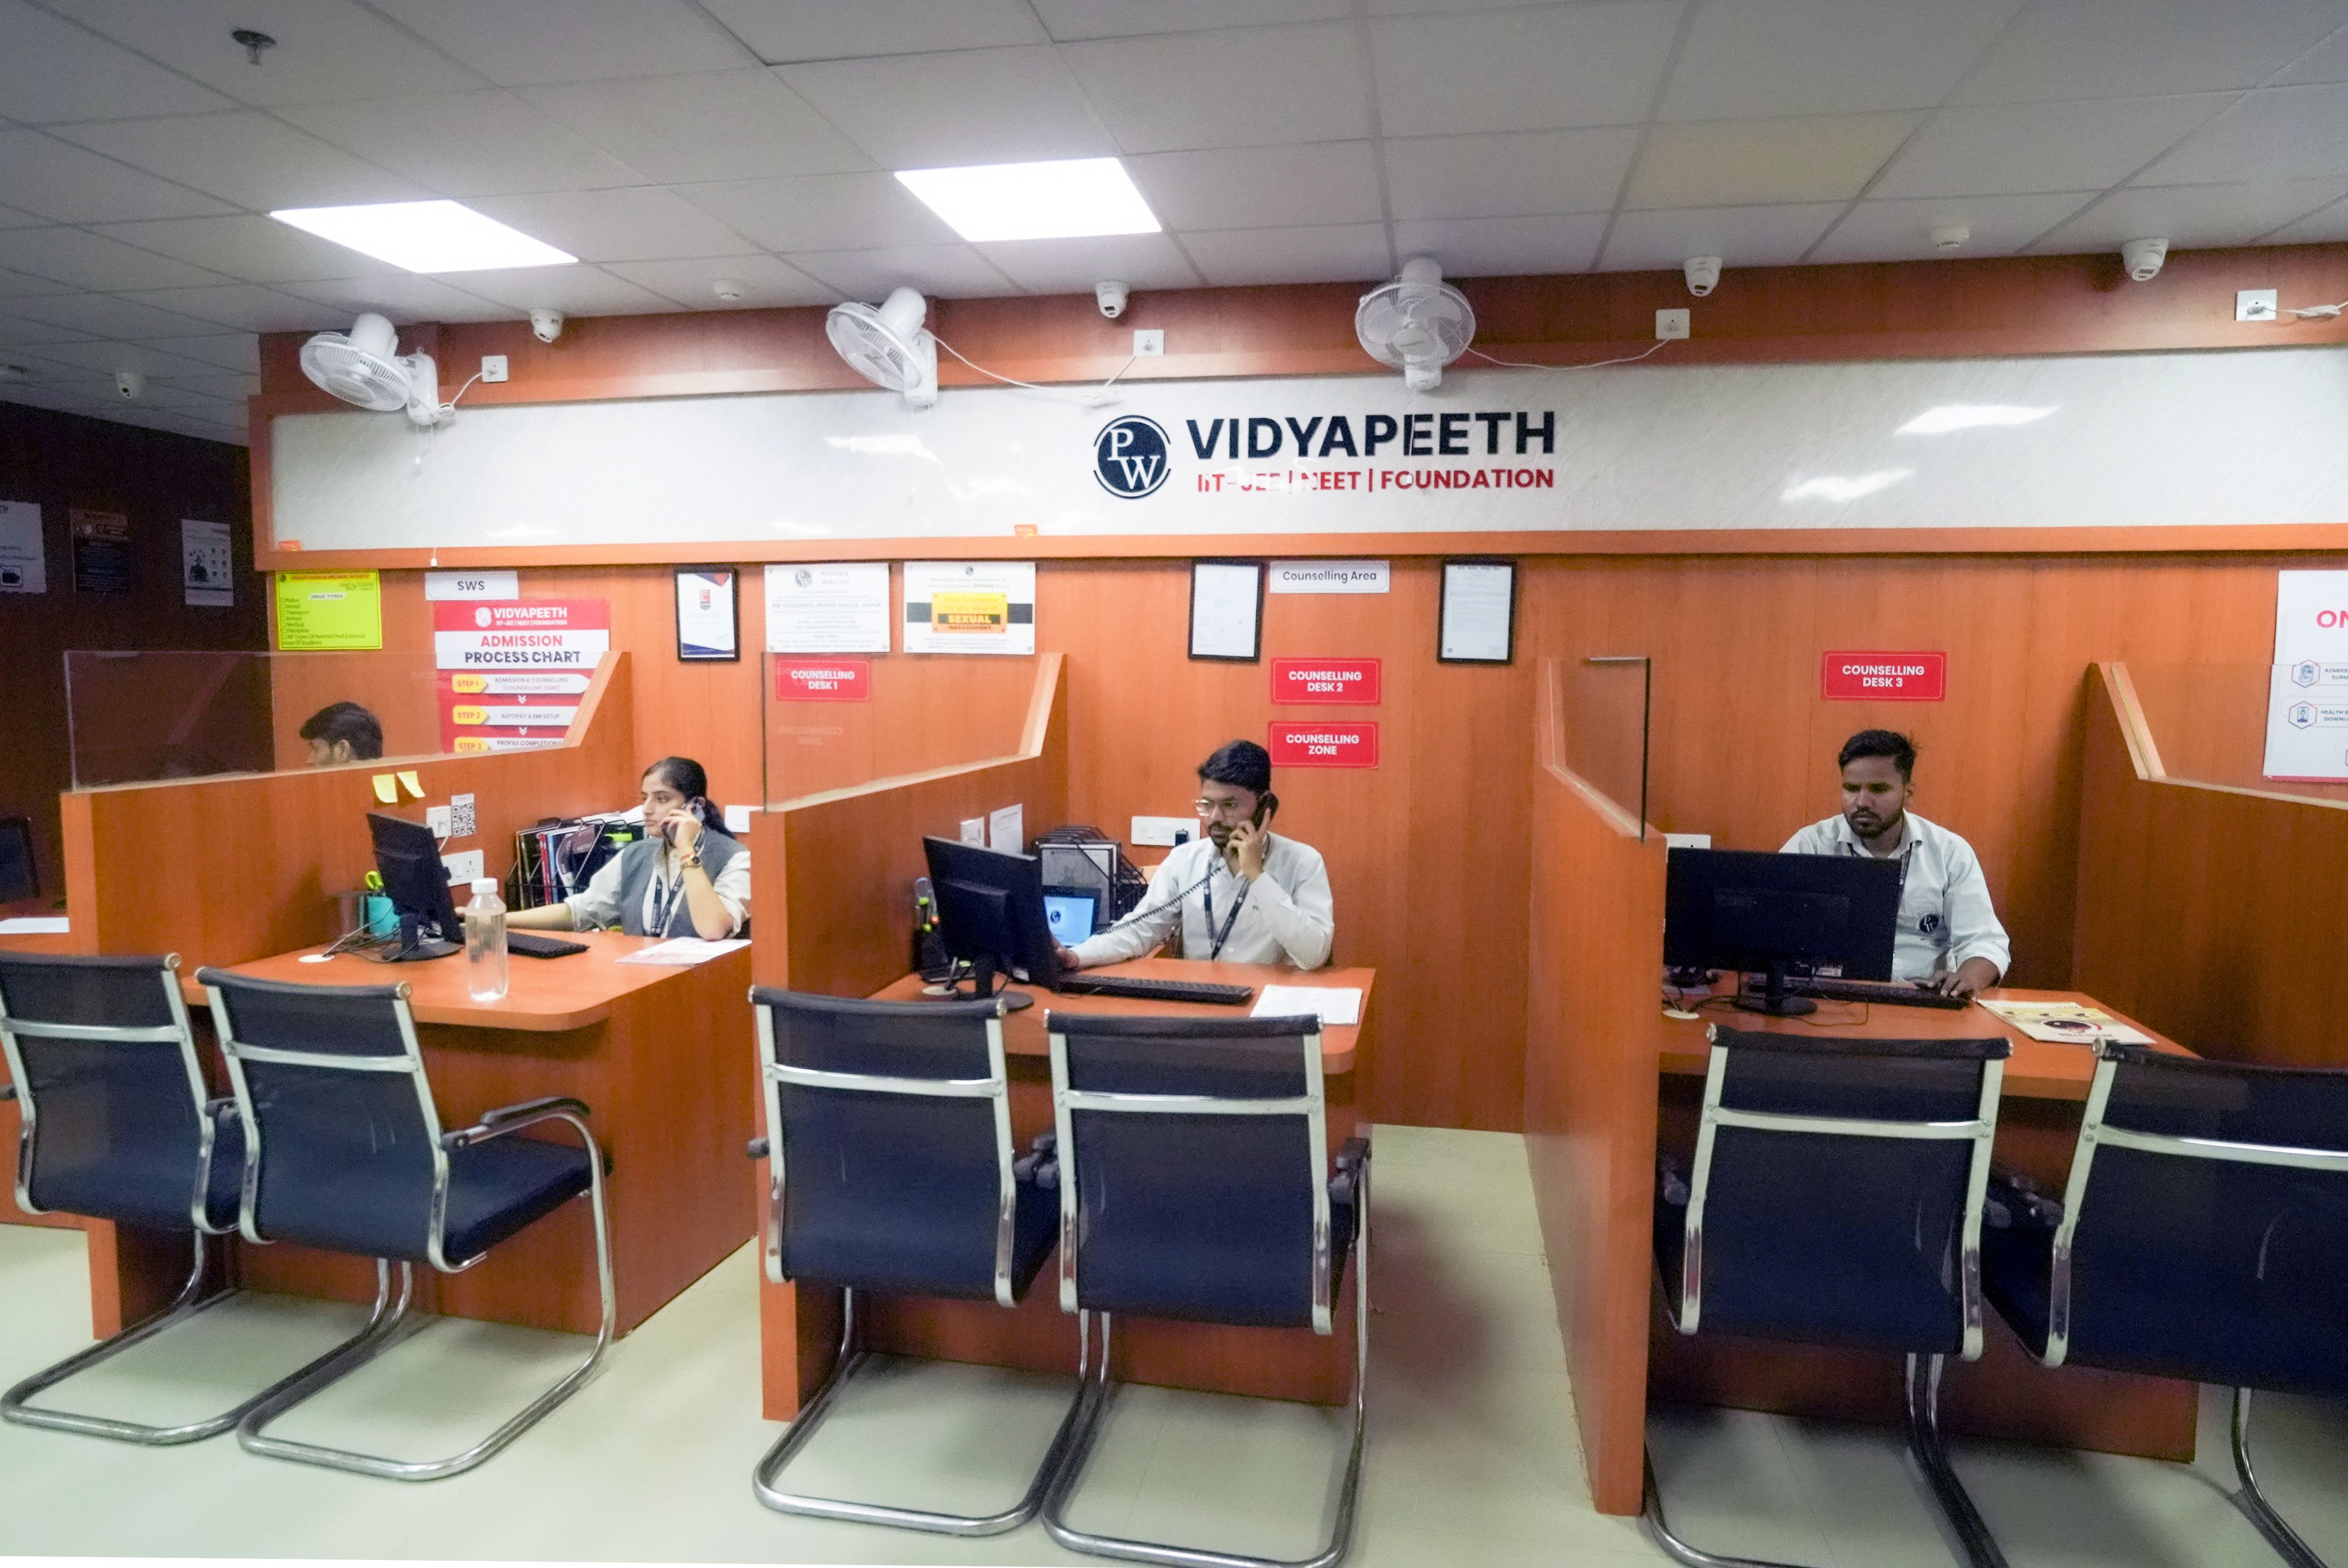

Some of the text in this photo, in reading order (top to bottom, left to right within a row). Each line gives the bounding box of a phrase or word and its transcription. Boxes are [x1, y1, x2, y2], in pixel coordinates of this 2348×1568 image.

[1186, 411, 1554, 459] VIDYAPEETH
[1107, 428, 1161, 490] PW
[1301, 471, 1361, 490] NEET
[1381, 469, 1554, 489] FOUNDATION
[1283, 571, 1377, 584] Counselling Area
[458, 580, 485, 591] SWS
[493, 607, 567, 618] VIDYAPEETH
[948, 614, 992, 624] SEXUAL
[481, 635, 563, 647] ADMISSION
[465, 651, 580, 663] PROCESS CHART
[791, 670, 855, 680] COUNSELLING
[1842, 665, 1925, 675] COUNSELLING
[1288, 671, 1362, 681] COUNSELLING
[808, 681, 838, 690] DESK 1
[1307, 683, 1344, 692] DESK 2
[1863, 678, 1903, 687] DESK 3
[1286, 734, 1360, 744] COUNSELLING
[1308, 745, 1337, 755] ZONE
